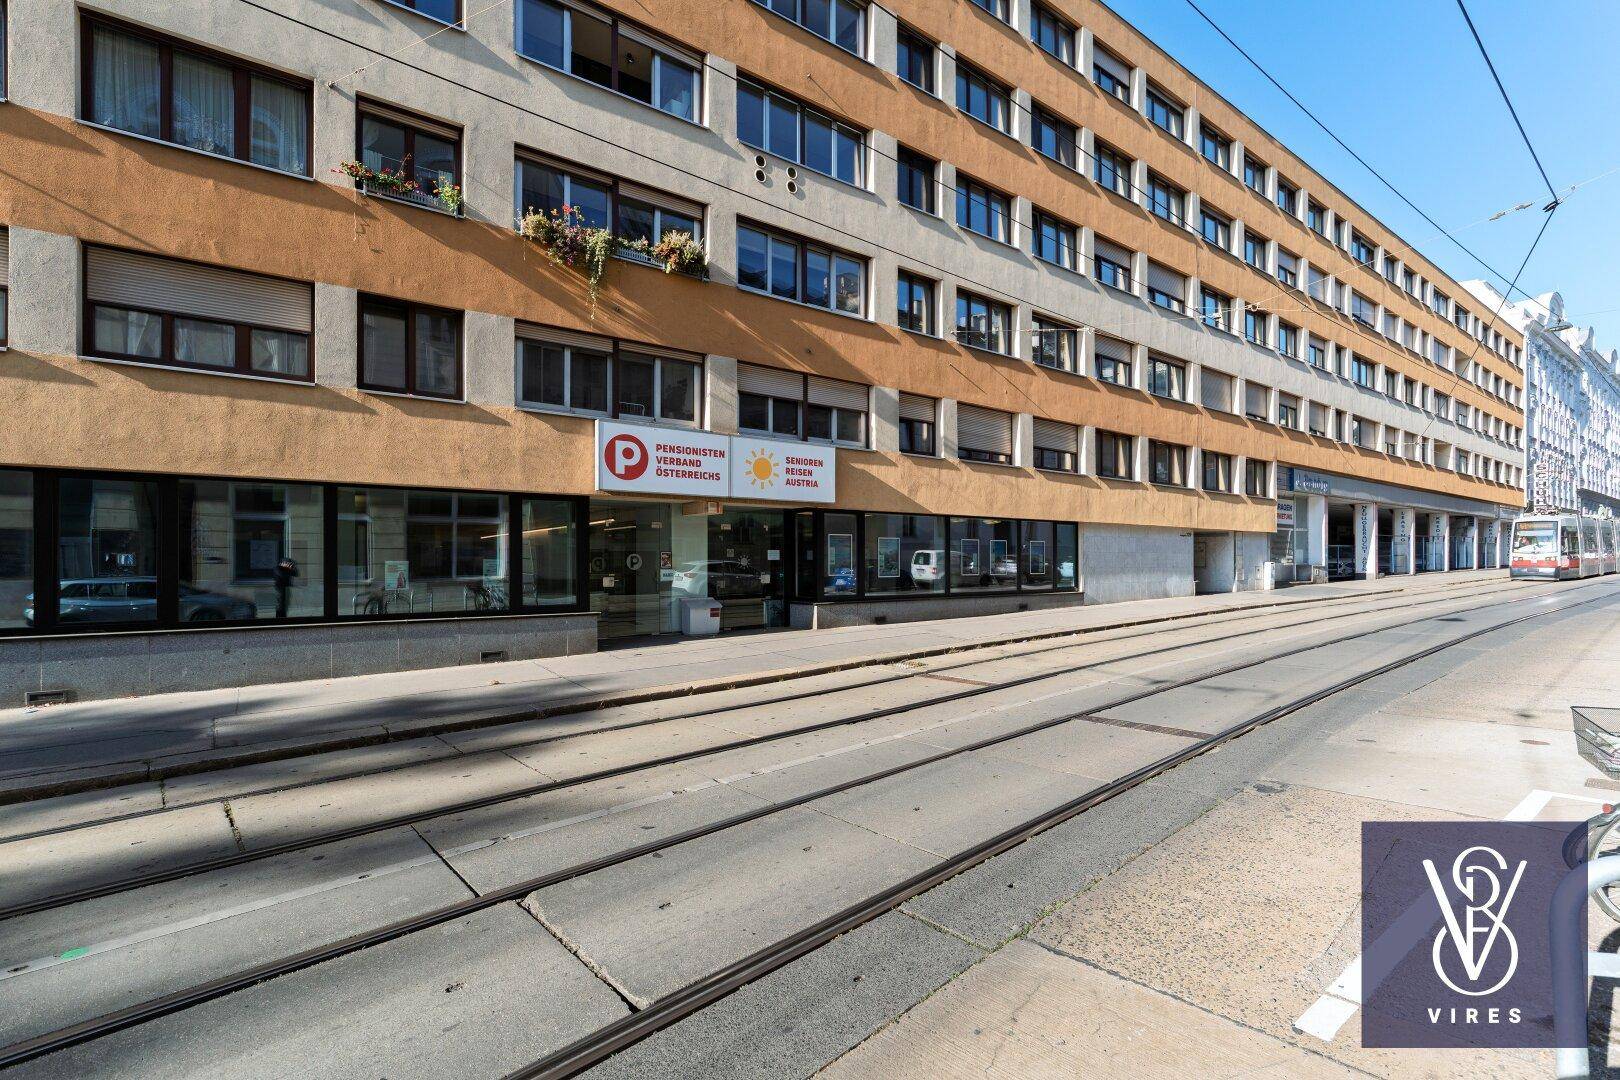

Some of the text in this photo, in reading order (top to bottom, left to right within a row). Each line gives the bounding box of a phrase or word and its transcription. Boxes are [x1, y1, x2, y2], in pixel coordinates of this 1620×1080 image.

[655, 443, 726, 459] PENSIONISTEN
[656, 456, 702, 468] VERBAND
[785, 456, 824, 468] SENIOREN
[655, 465, 721, 481] ÖSTERREICHS
[785, 467, 813, 477] REISEN
[785, 478, 819, 488] AUSTRIA
